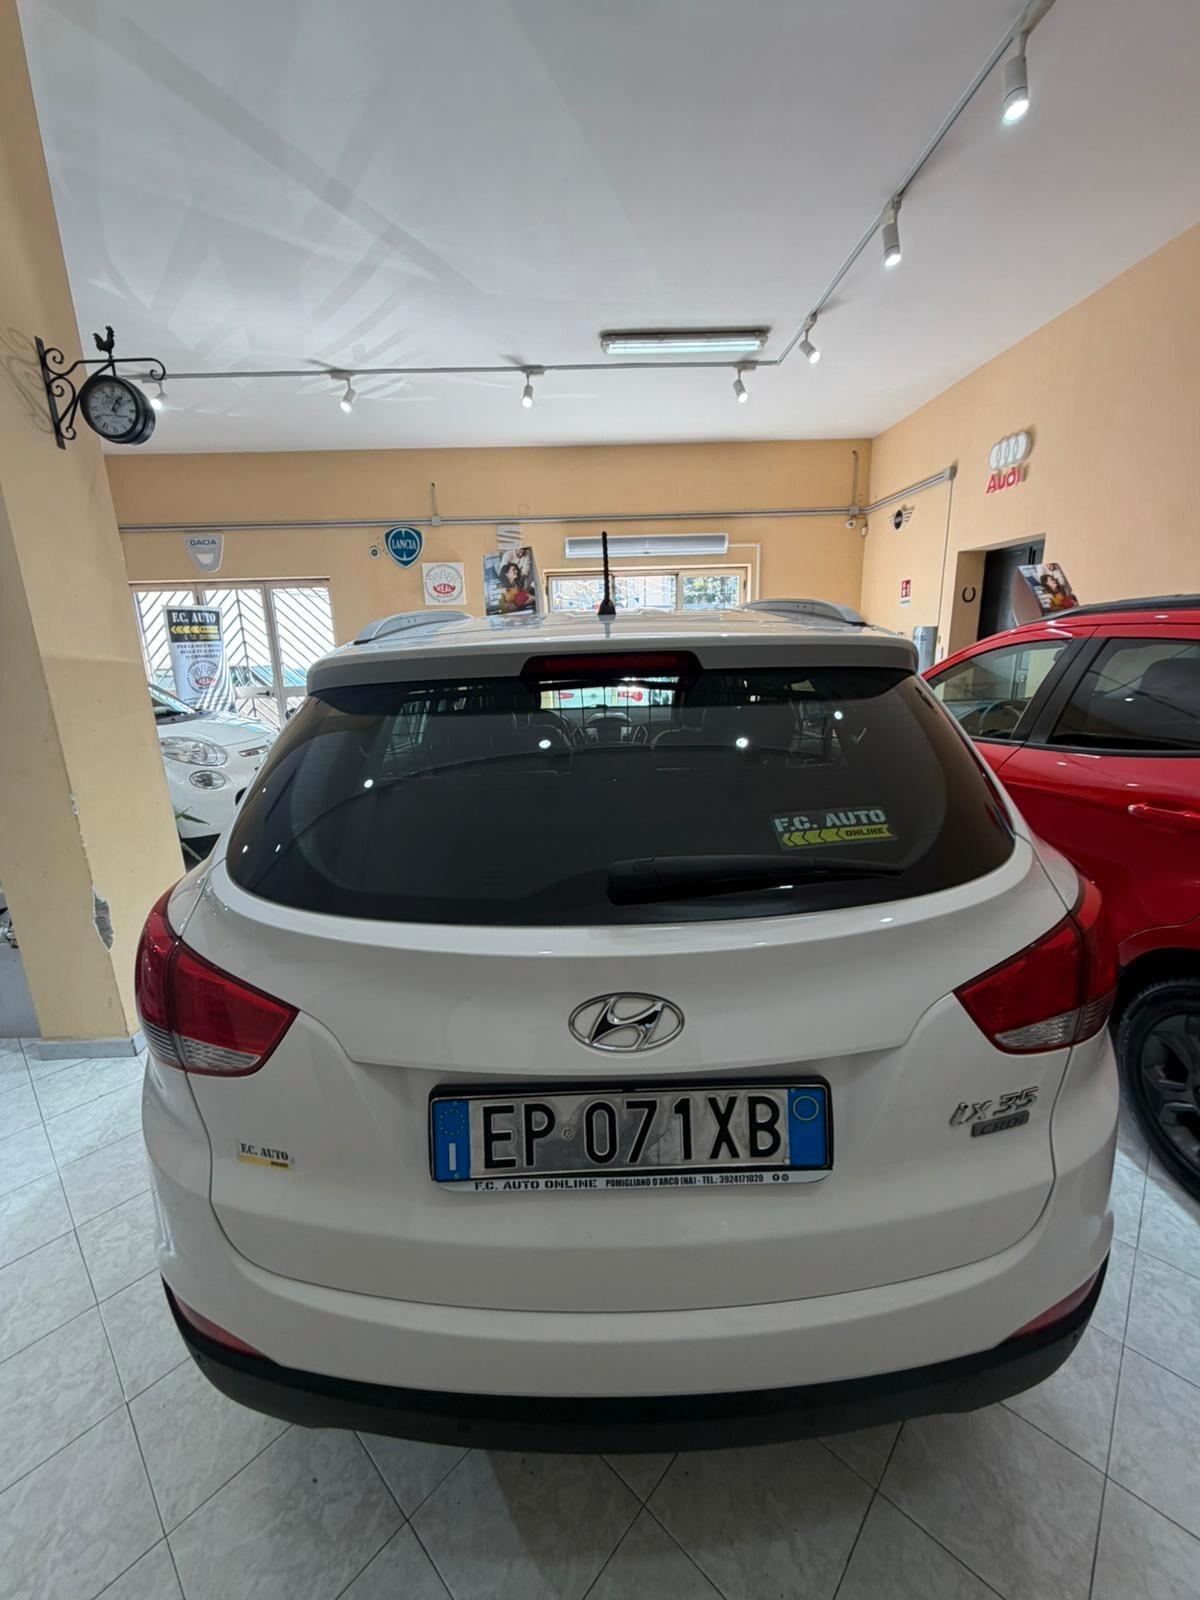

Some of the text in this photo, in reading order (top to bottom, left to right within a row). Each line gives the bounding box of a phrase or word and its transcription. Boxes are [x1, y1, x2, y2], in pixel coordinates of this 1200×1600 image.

[985, 466, 1022, 495] Audi
[391, 538, 417, 550] LANCIA
[171, 611, 217, 623] F.C. AUTO
[774, 809, 887, 833] F.C. AUTO
[844, 827, 886, 837] ONLINE
[260, 1147, 289, 1161] AUTO
[475, 1180, 498, 1190] F.C.
[503, 1180, 540, 1190] AUTO
[544, 1178, 598, 1189] ONLINE
[605, 1178, 651, 1187] POMIGLIANO
[652, 1176, 679, 1187] D'ARCO
